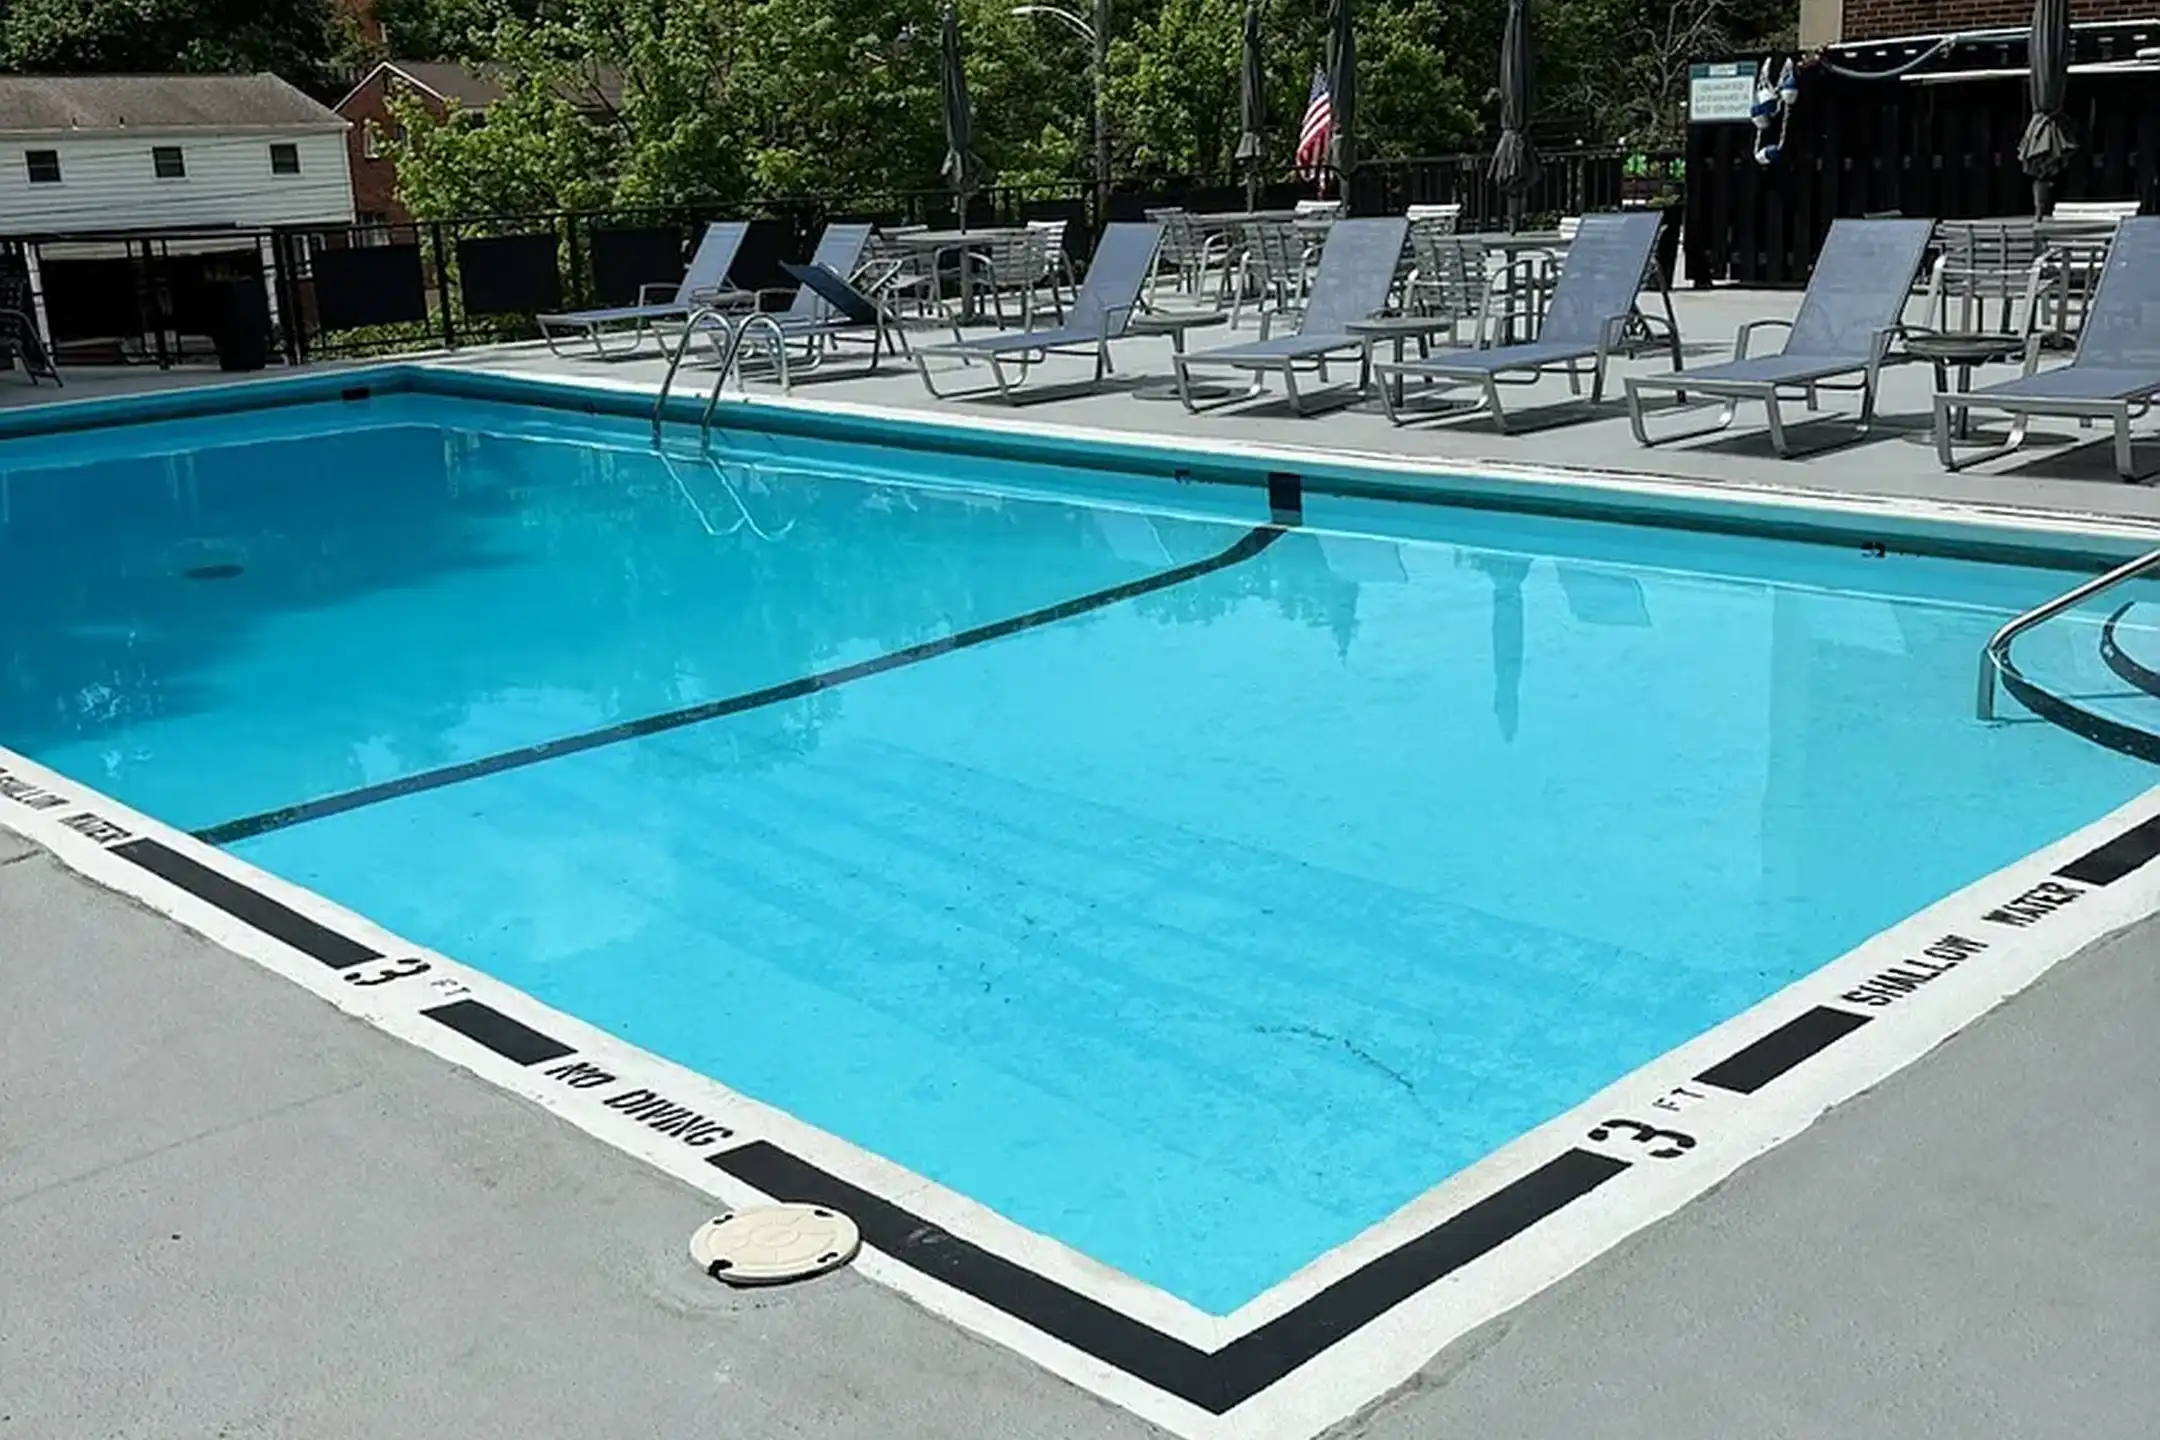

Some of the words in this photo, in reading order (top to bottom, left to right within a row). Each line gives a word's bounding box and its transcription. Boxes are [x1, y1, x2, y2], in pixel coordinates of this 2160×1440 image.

[343, 958, 431, 986] 3
[430, 979, 471, 997] FT
[1841, 934, 1989, 1006] SHALLOW
[1980, 882, 2086, 927] WATER
[544, 1062, 617, 1088] NO
[603, 1088, 734, 1146] DIVING
[1587, 1118, 1697, 1159] 3
[1652, 1087, 1705, 1112] FT
